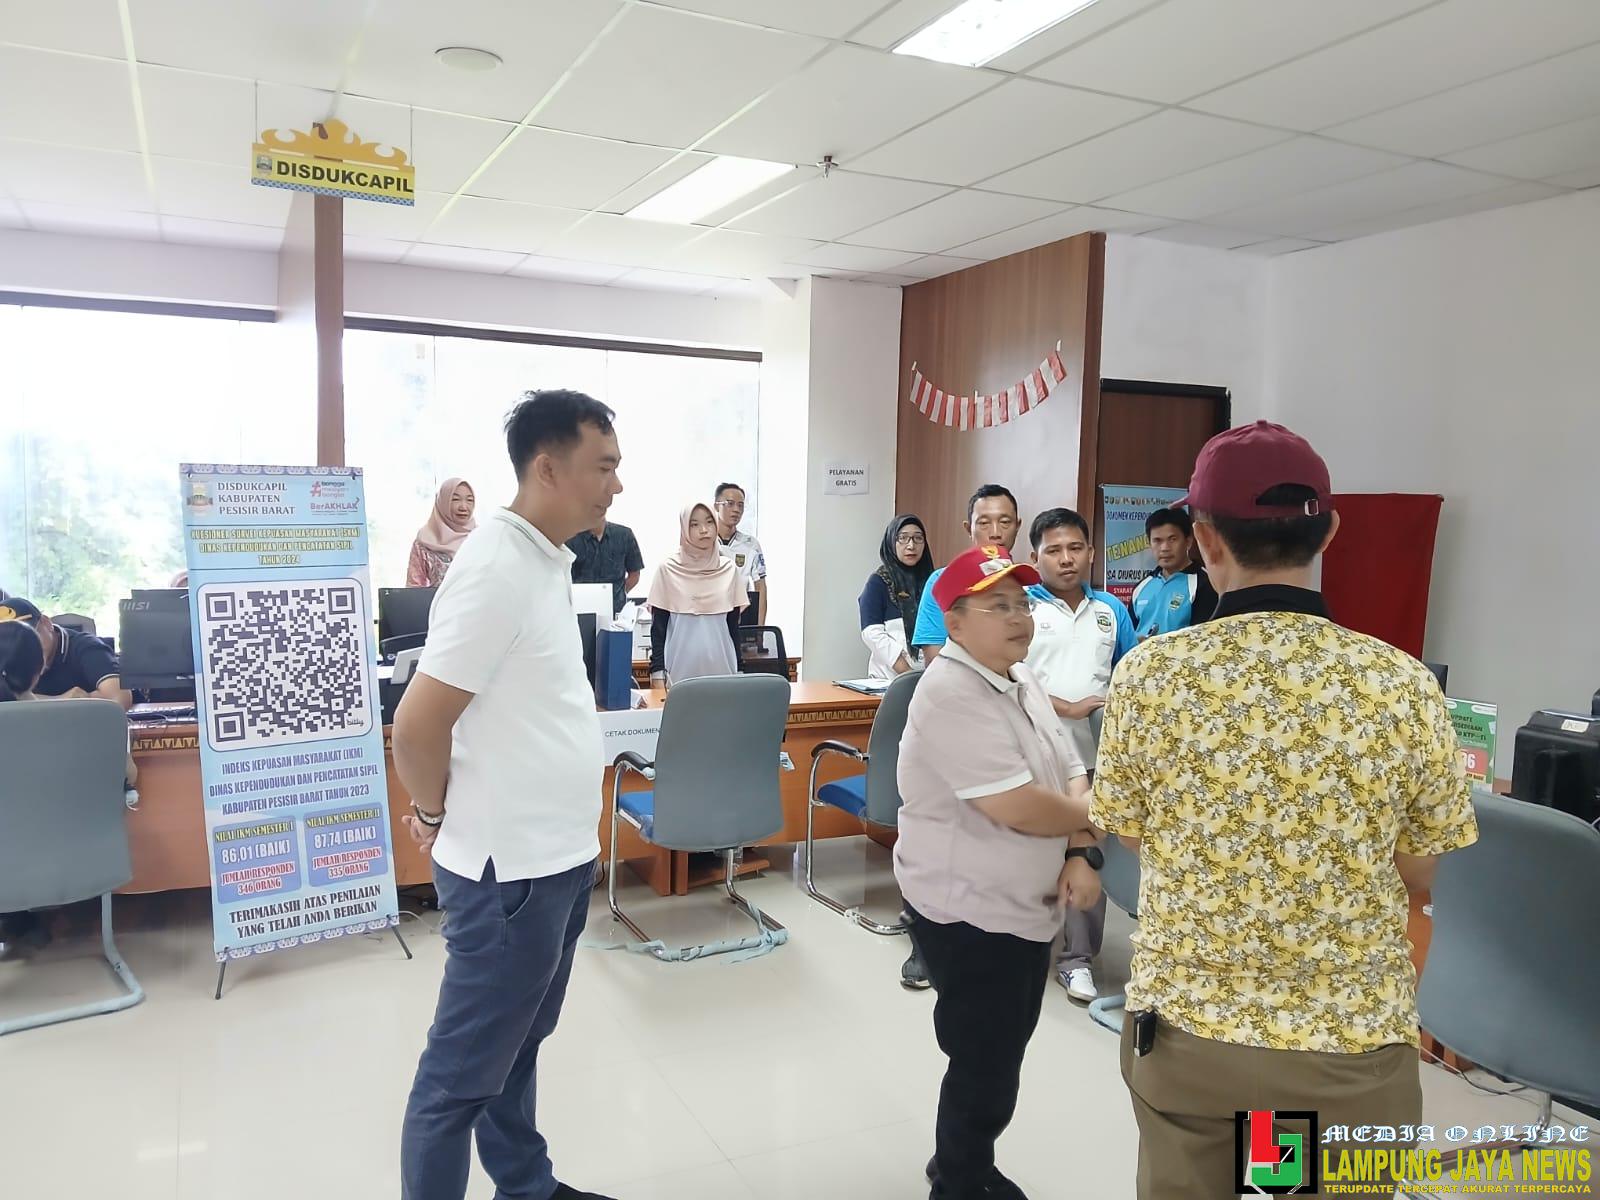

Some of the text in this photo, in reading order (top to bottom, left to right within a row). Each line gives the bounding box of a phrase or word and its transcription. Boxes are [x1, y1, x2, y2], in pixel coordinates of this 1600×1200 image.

[276, 160, 414, 192] DISDUKCAPIL
[218, 482, 288, 491] DISDUKCAPIL
[218, 494, 280, 503] KABUPATEN
[219, 506, 295, 515] PESISIR BARAT
[1118, 570, 1141, 580] DIURUS
[222, 747, 363, 775] INDEKS KEPUASAN MASYARAKAT (IKM)
[210, 764, 378, 797] DINAS KEPENDUDUKAN DAN PENCATATAN SIPIL
[222, 784, 370, 816] KABUPATEN PESISIR BARAT TAHUN 2023
[326, 814, 340, 824] IKM
[340, 810, 372, 822] SEMESTER
[236, 828, 251, 840] IKM
[252, 822, 288, 836] SEMESTER
[314, 826, 376, 849] 87,74 (BAIK)
[222, 840, 290, 864] 86,01 (BAIK)
[313, 846, 382, 870] JUMLAH RESPONDEN
[222, 862, 295, 886] JUMLAH RESPONDEN
[328, 862, 370, 878] 335 ORANG
[238, 877, 282, 895] 346 ORANG
[229, 884, 381, 924] TERIMAKASIH ATAS PENILAIAN
[236, 900, 378, 939] YANG TELAH ANDA BERIKAN
